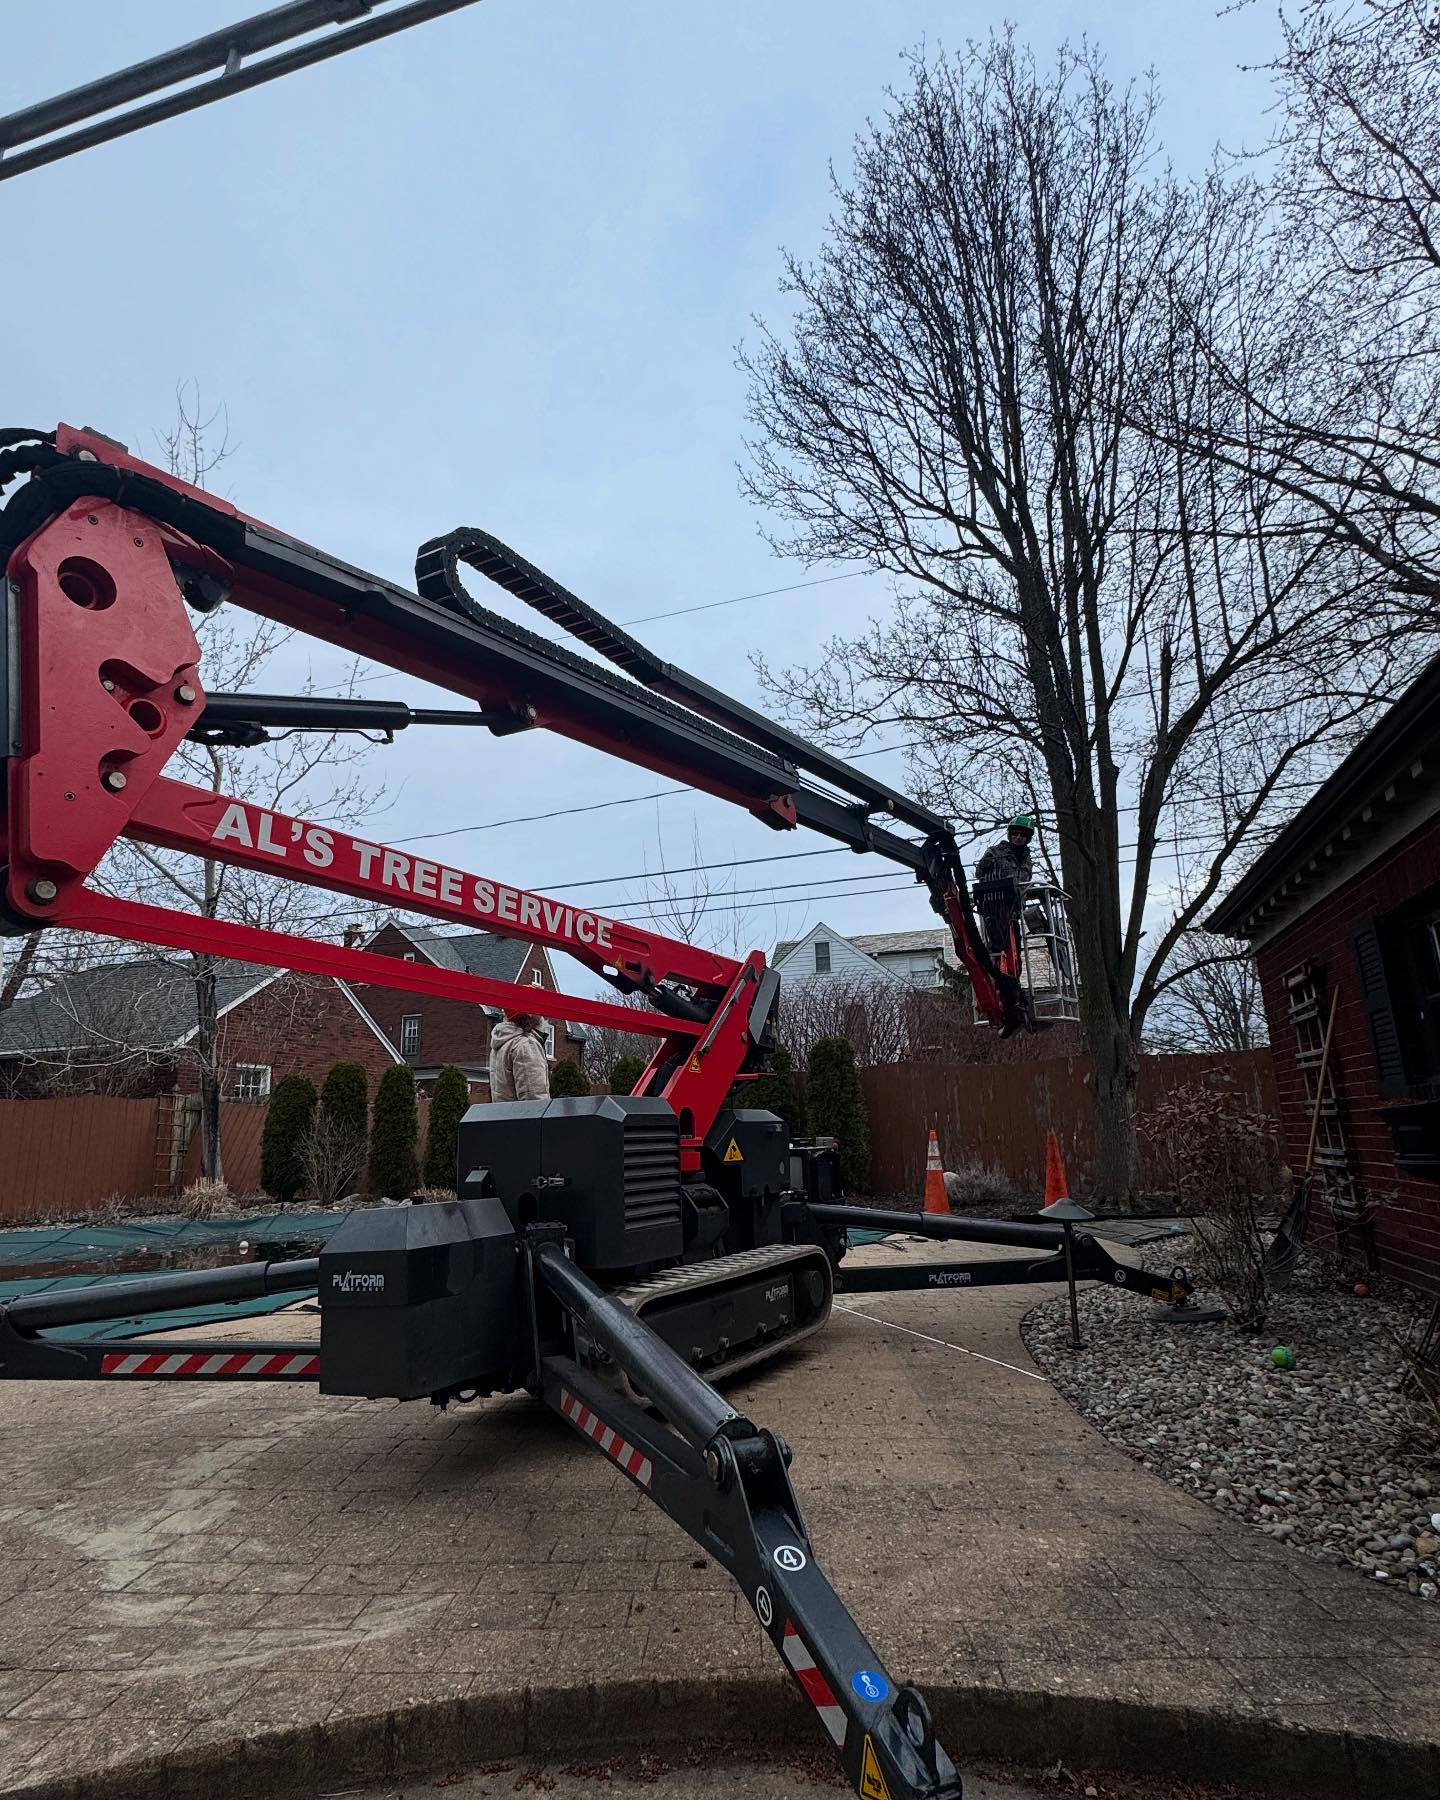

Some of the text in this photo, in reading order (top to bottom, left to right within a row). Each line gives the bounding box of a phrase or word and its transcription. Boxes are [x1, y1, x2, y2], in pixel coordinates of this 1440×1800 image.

[212, 803, 614, 949] AL'S TREE SERVICE
[332, 1270, 385, 1288] PLATFORM
[928, 1272, 971, 1284] PLATFORM
